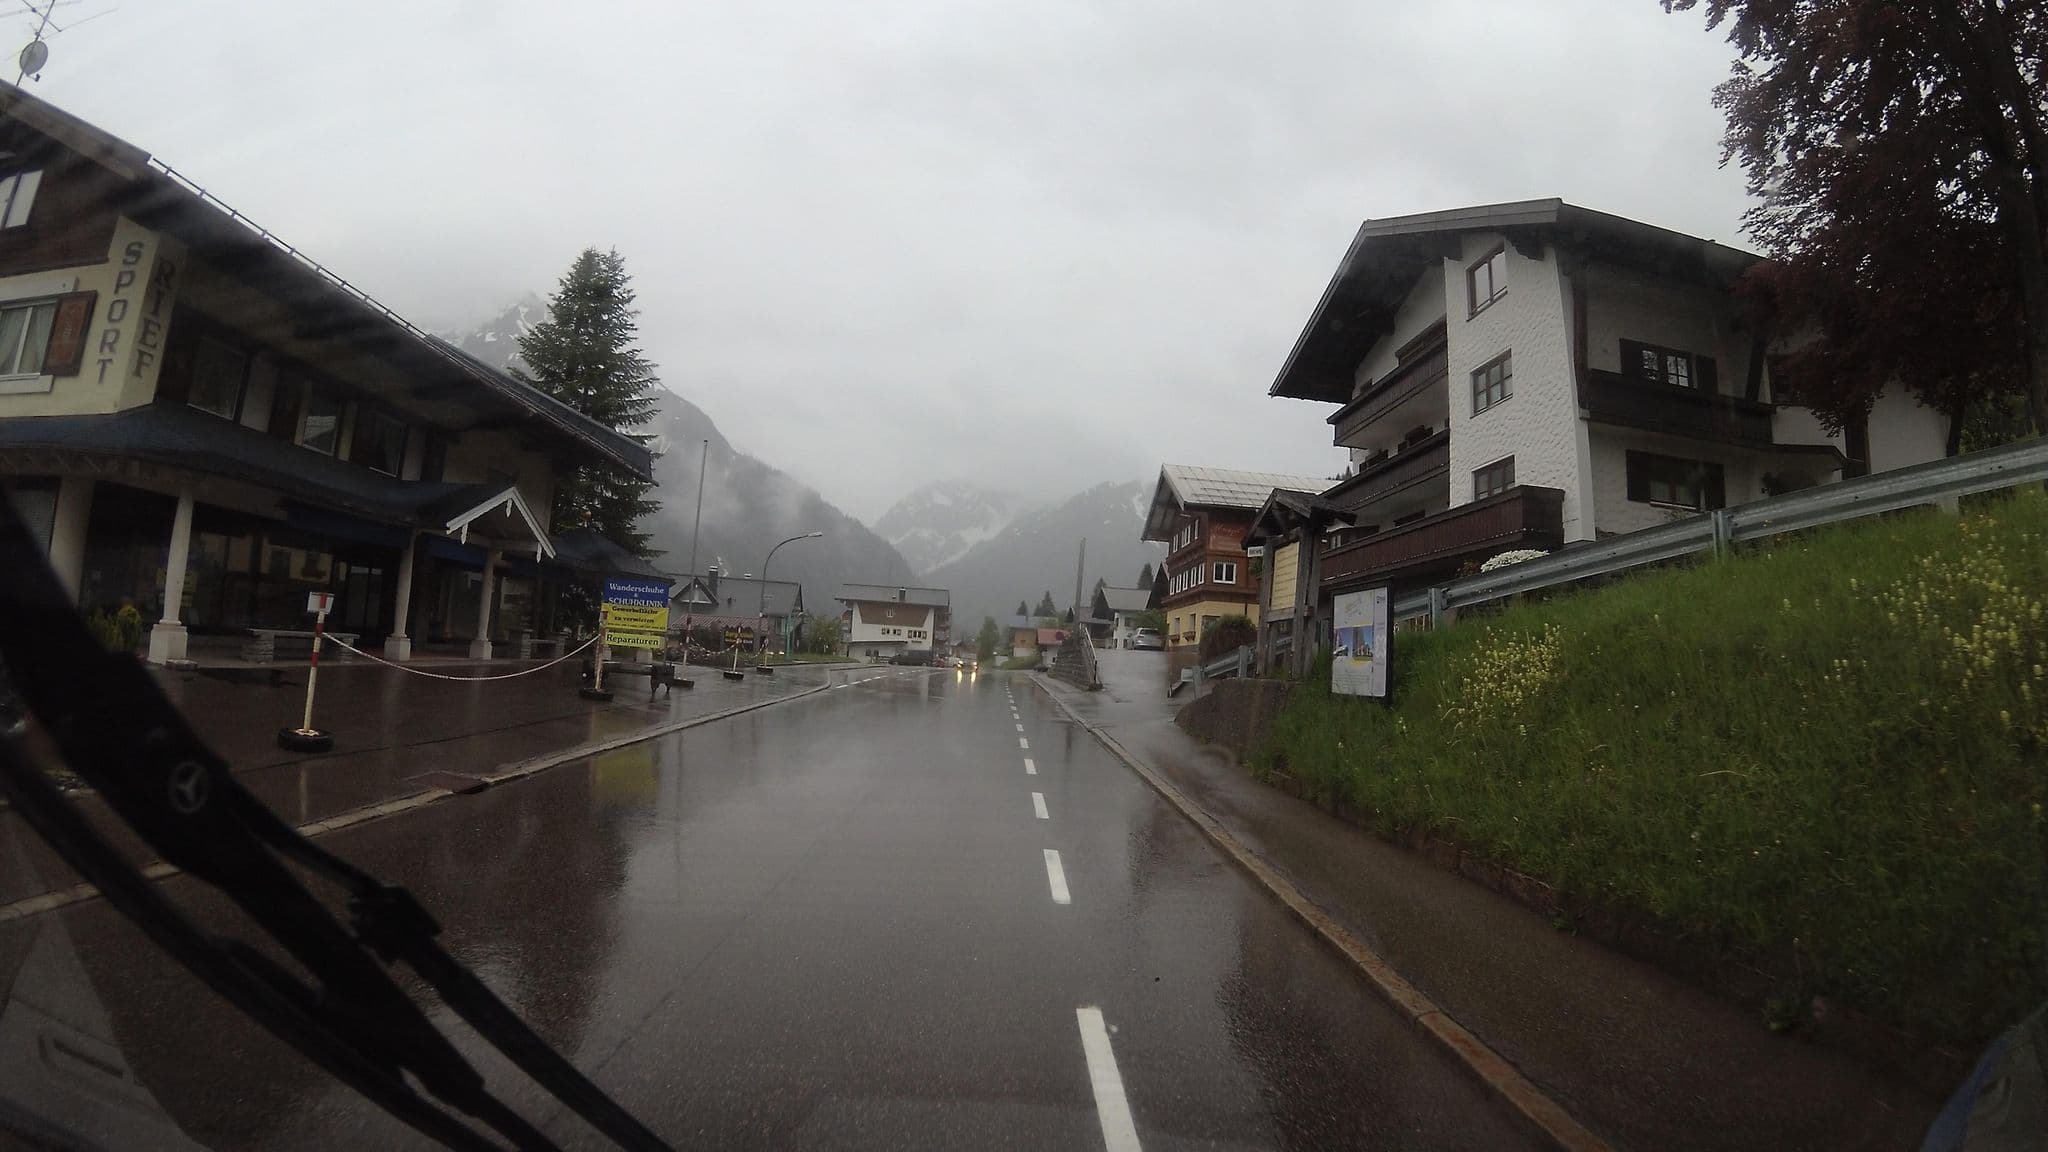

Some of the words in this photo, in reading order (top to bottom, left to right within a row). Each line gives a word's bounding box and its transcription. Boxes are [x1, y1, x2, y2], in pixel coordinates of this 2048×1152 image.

[97, 241, 145, 384] SPORT
[134, 260, 177, 379] RIEF
[609, 583, 664, 594] Wanderschuhe
[608, 597, 663, 607] SCHUHKLINIK
[606, 634, 659, 645] Reparaturen
